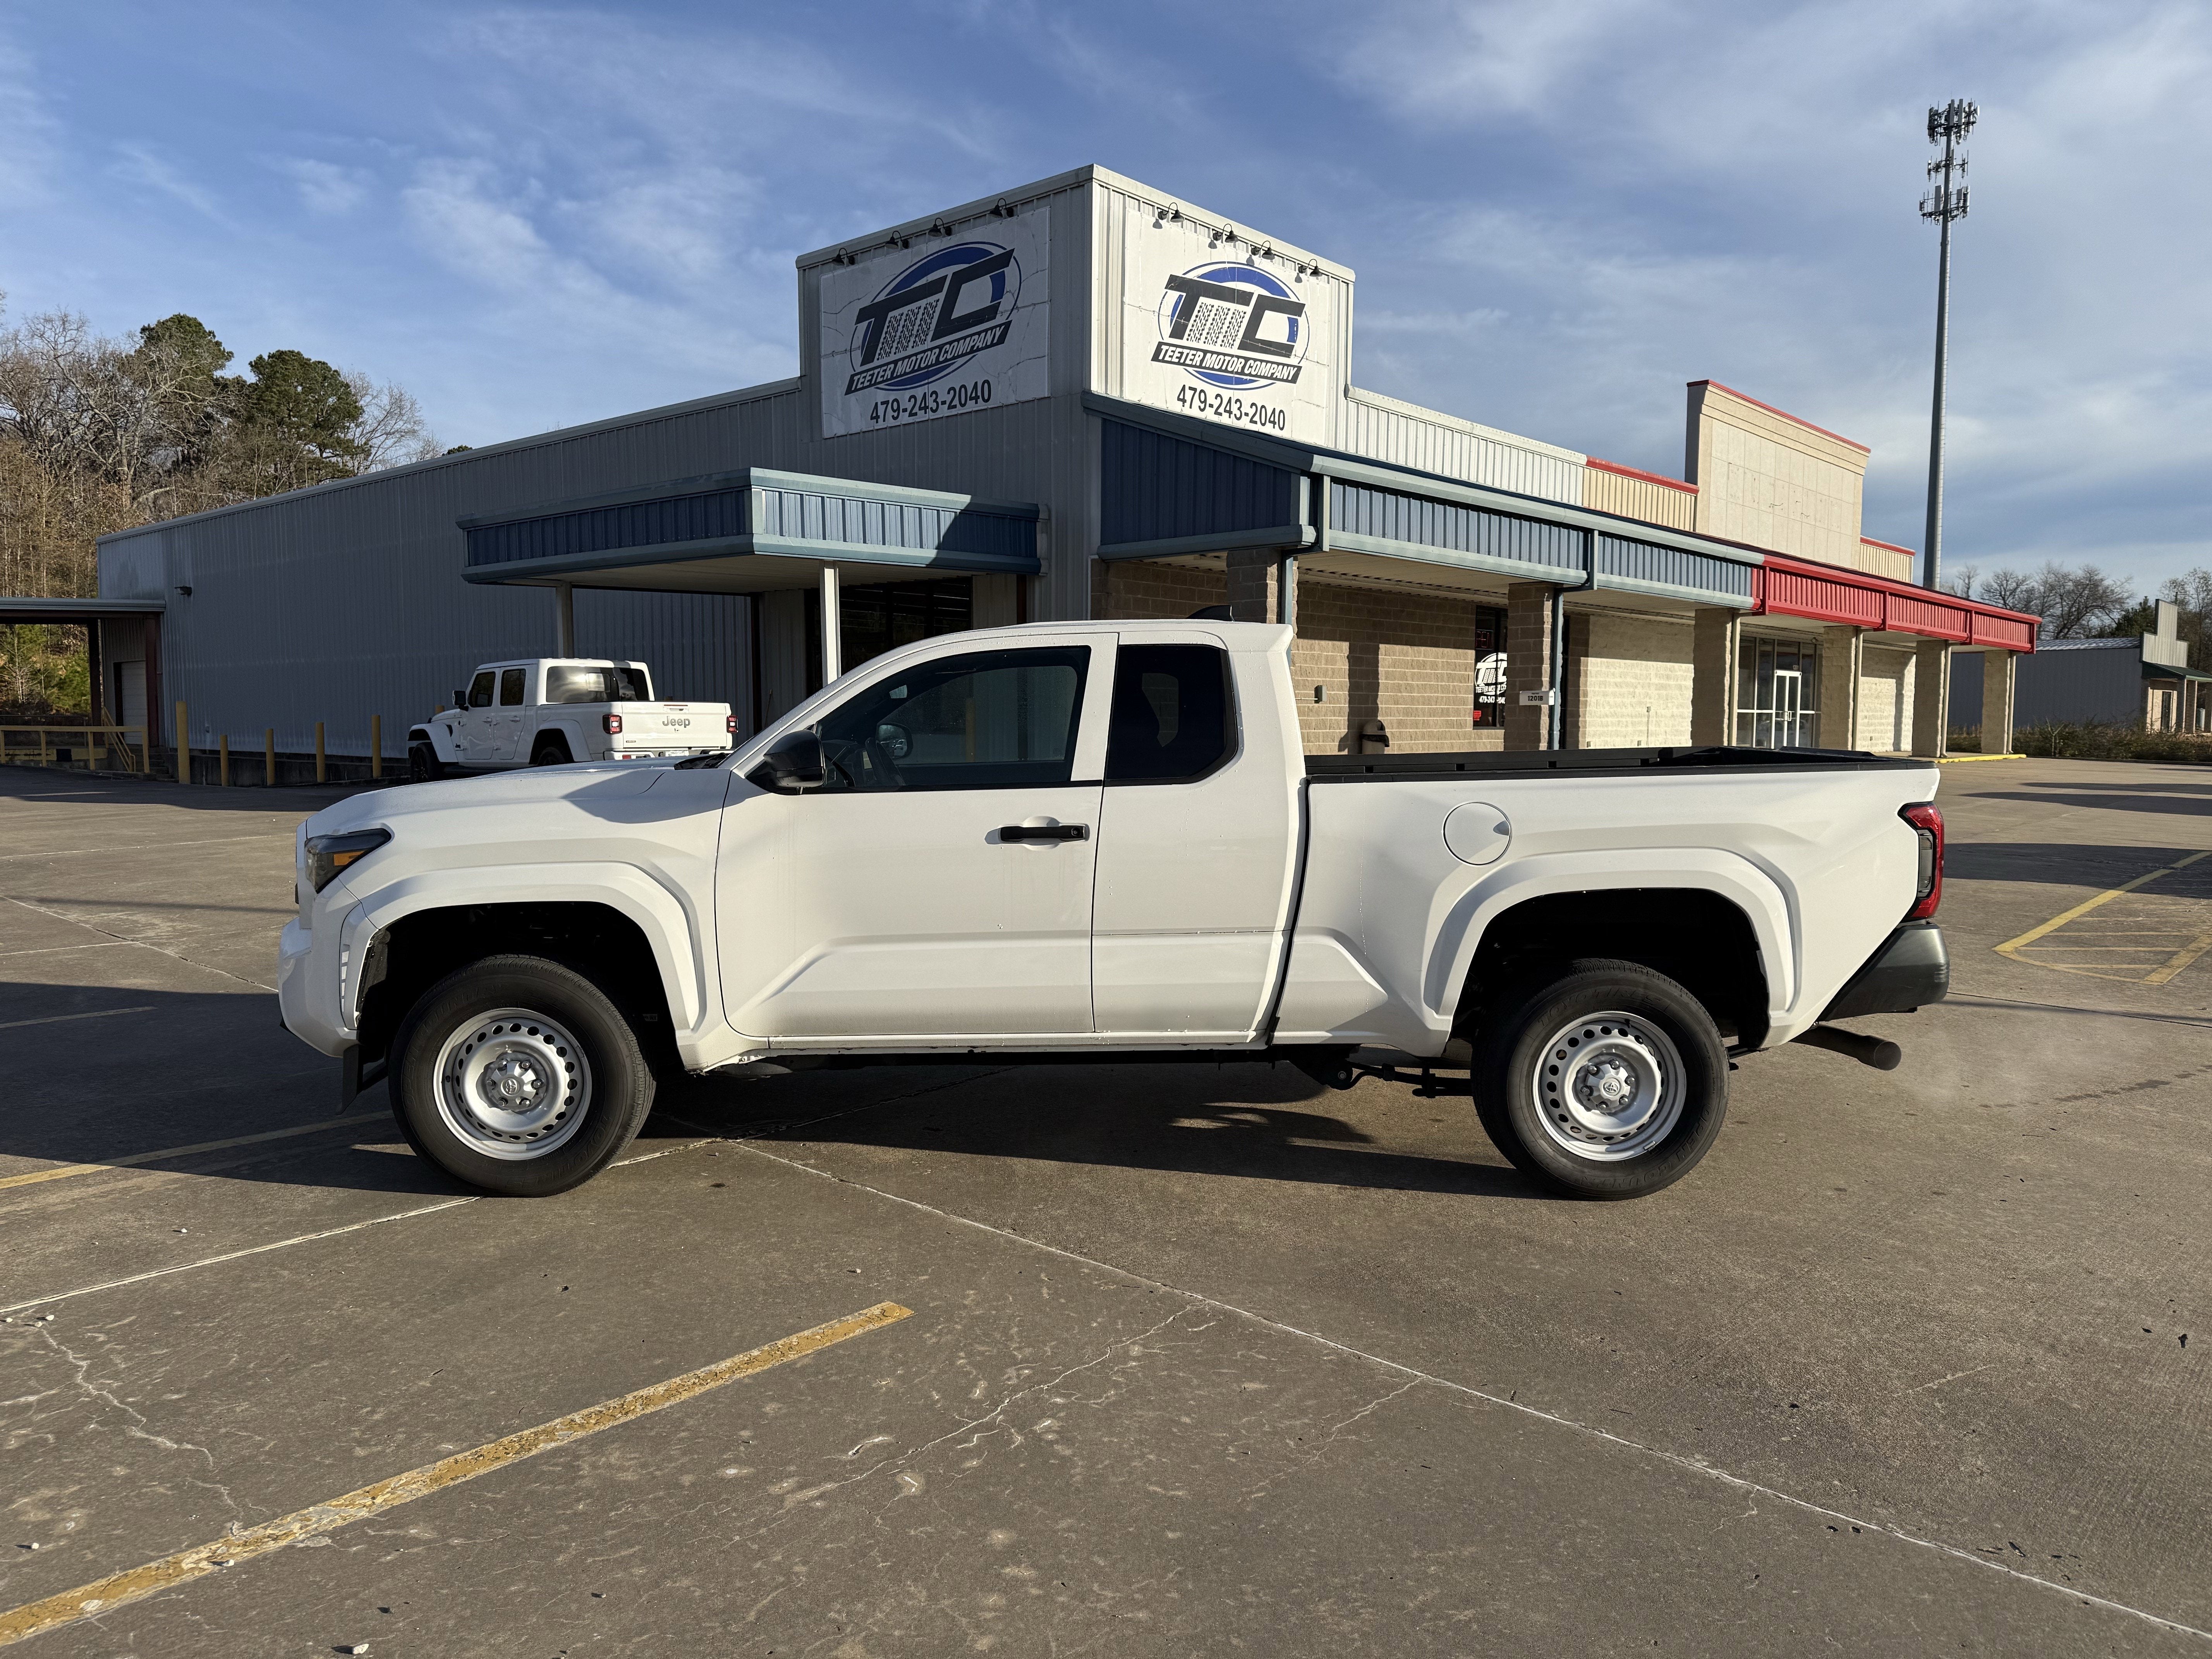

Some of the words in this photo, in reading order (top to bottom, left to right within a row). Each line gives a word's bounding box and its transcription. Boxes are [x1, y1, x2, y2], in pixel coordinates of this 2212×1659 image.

[852, 363, 895, 391] TEETER
[893, 348, 940, 377] MOTOR
[939, 325, 1005, 361] COMPANY
[1158, 345, 1203, 366] TEETER
[1202, 353, 1245, 373] MOTOR
[1244, 360, 1297, 380] COMPANY
[870, 379, 991, 424] 479-243-2040
[1177, 385, 1285, 431] 479-243-2040
[662, 716, 690, 728] Jeep
[1675, 1103, 1713, 1162] OPEN
